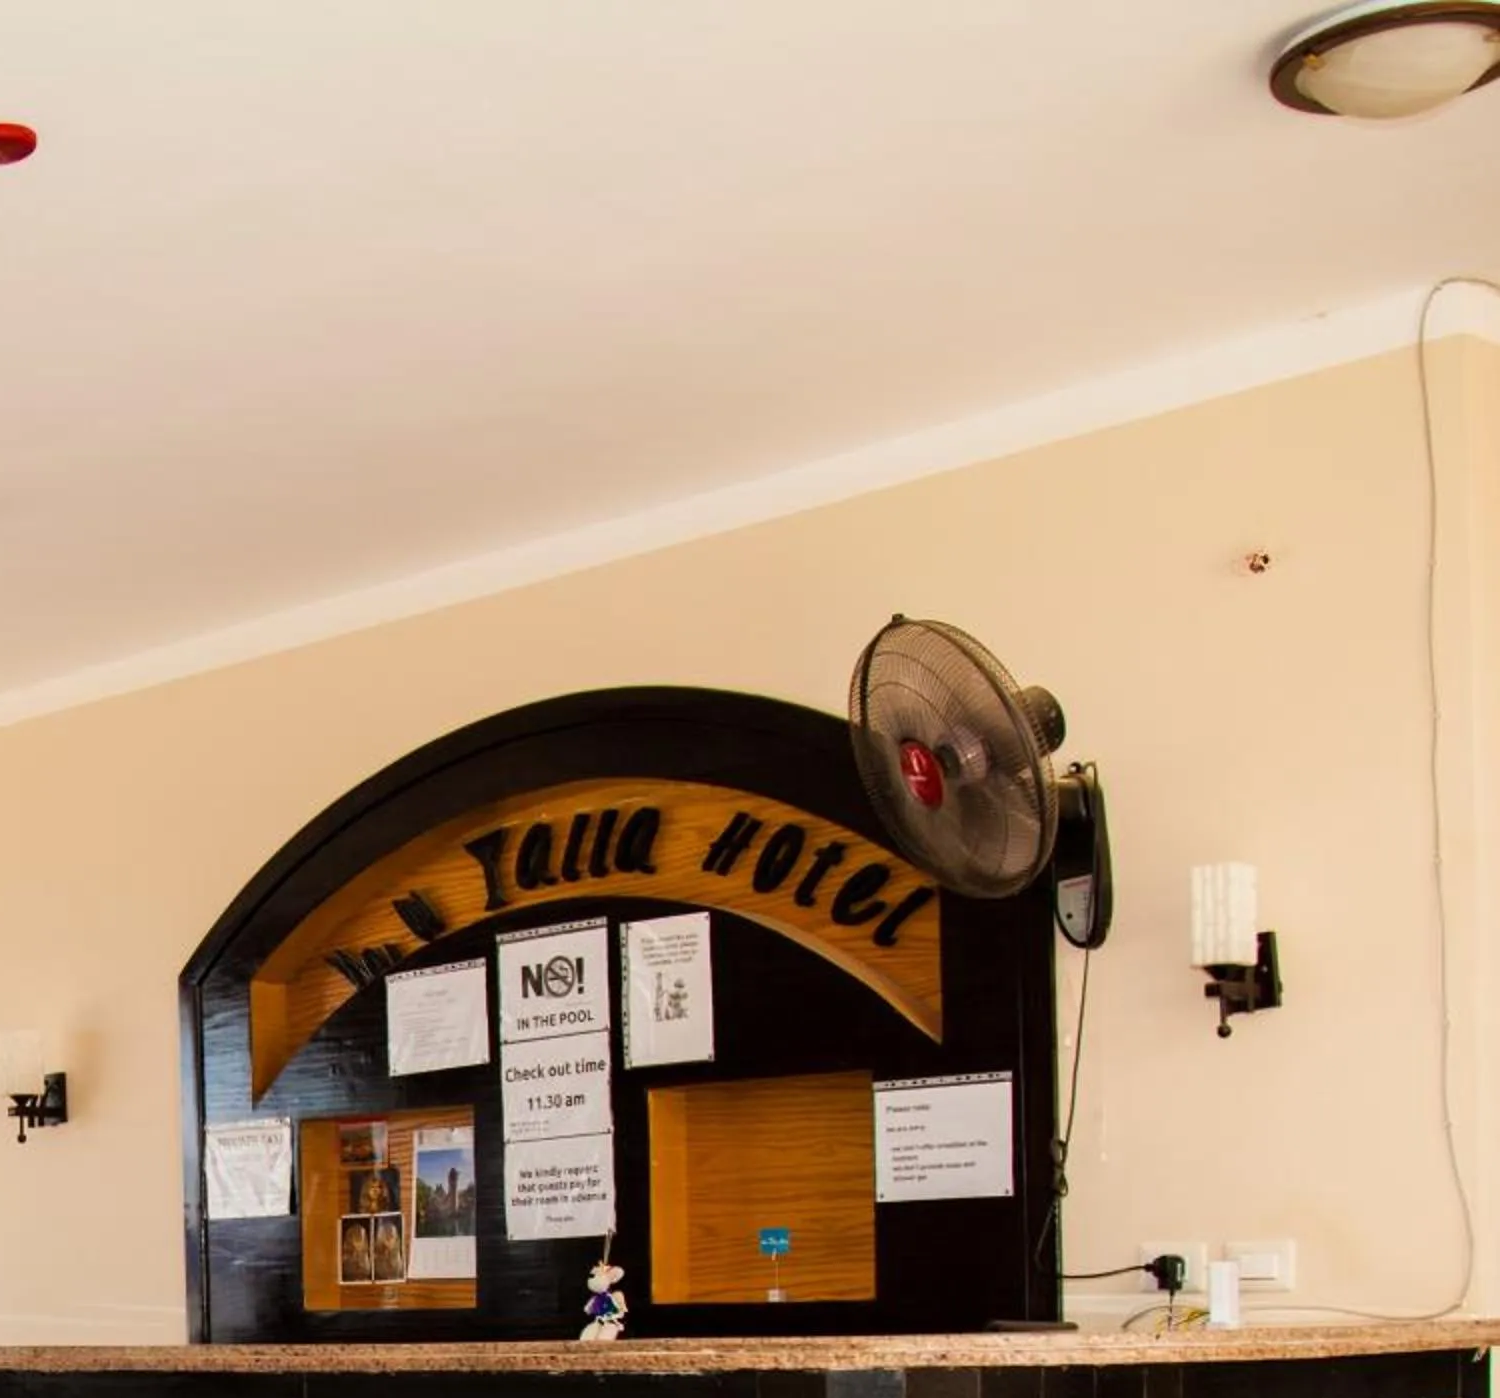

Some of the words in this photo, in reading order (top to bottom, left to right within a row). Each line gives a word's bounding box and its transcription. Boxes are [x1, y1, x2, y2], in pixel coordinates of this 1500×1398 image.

[702, 812, 935, 946] Hotel
[517, 1018, 530, 1030] IN
[533, 1014, 557, 1028] THE
[559, 1009, 594, 1025] POOL
[505, 1064, 545, 1083] Check
[548, 1063, 570, 1077] out
[575, 1057, 606, 1075] time
[527, 1094, 562, 1111] 11.30
[565, 1093, 585, 1106] am
